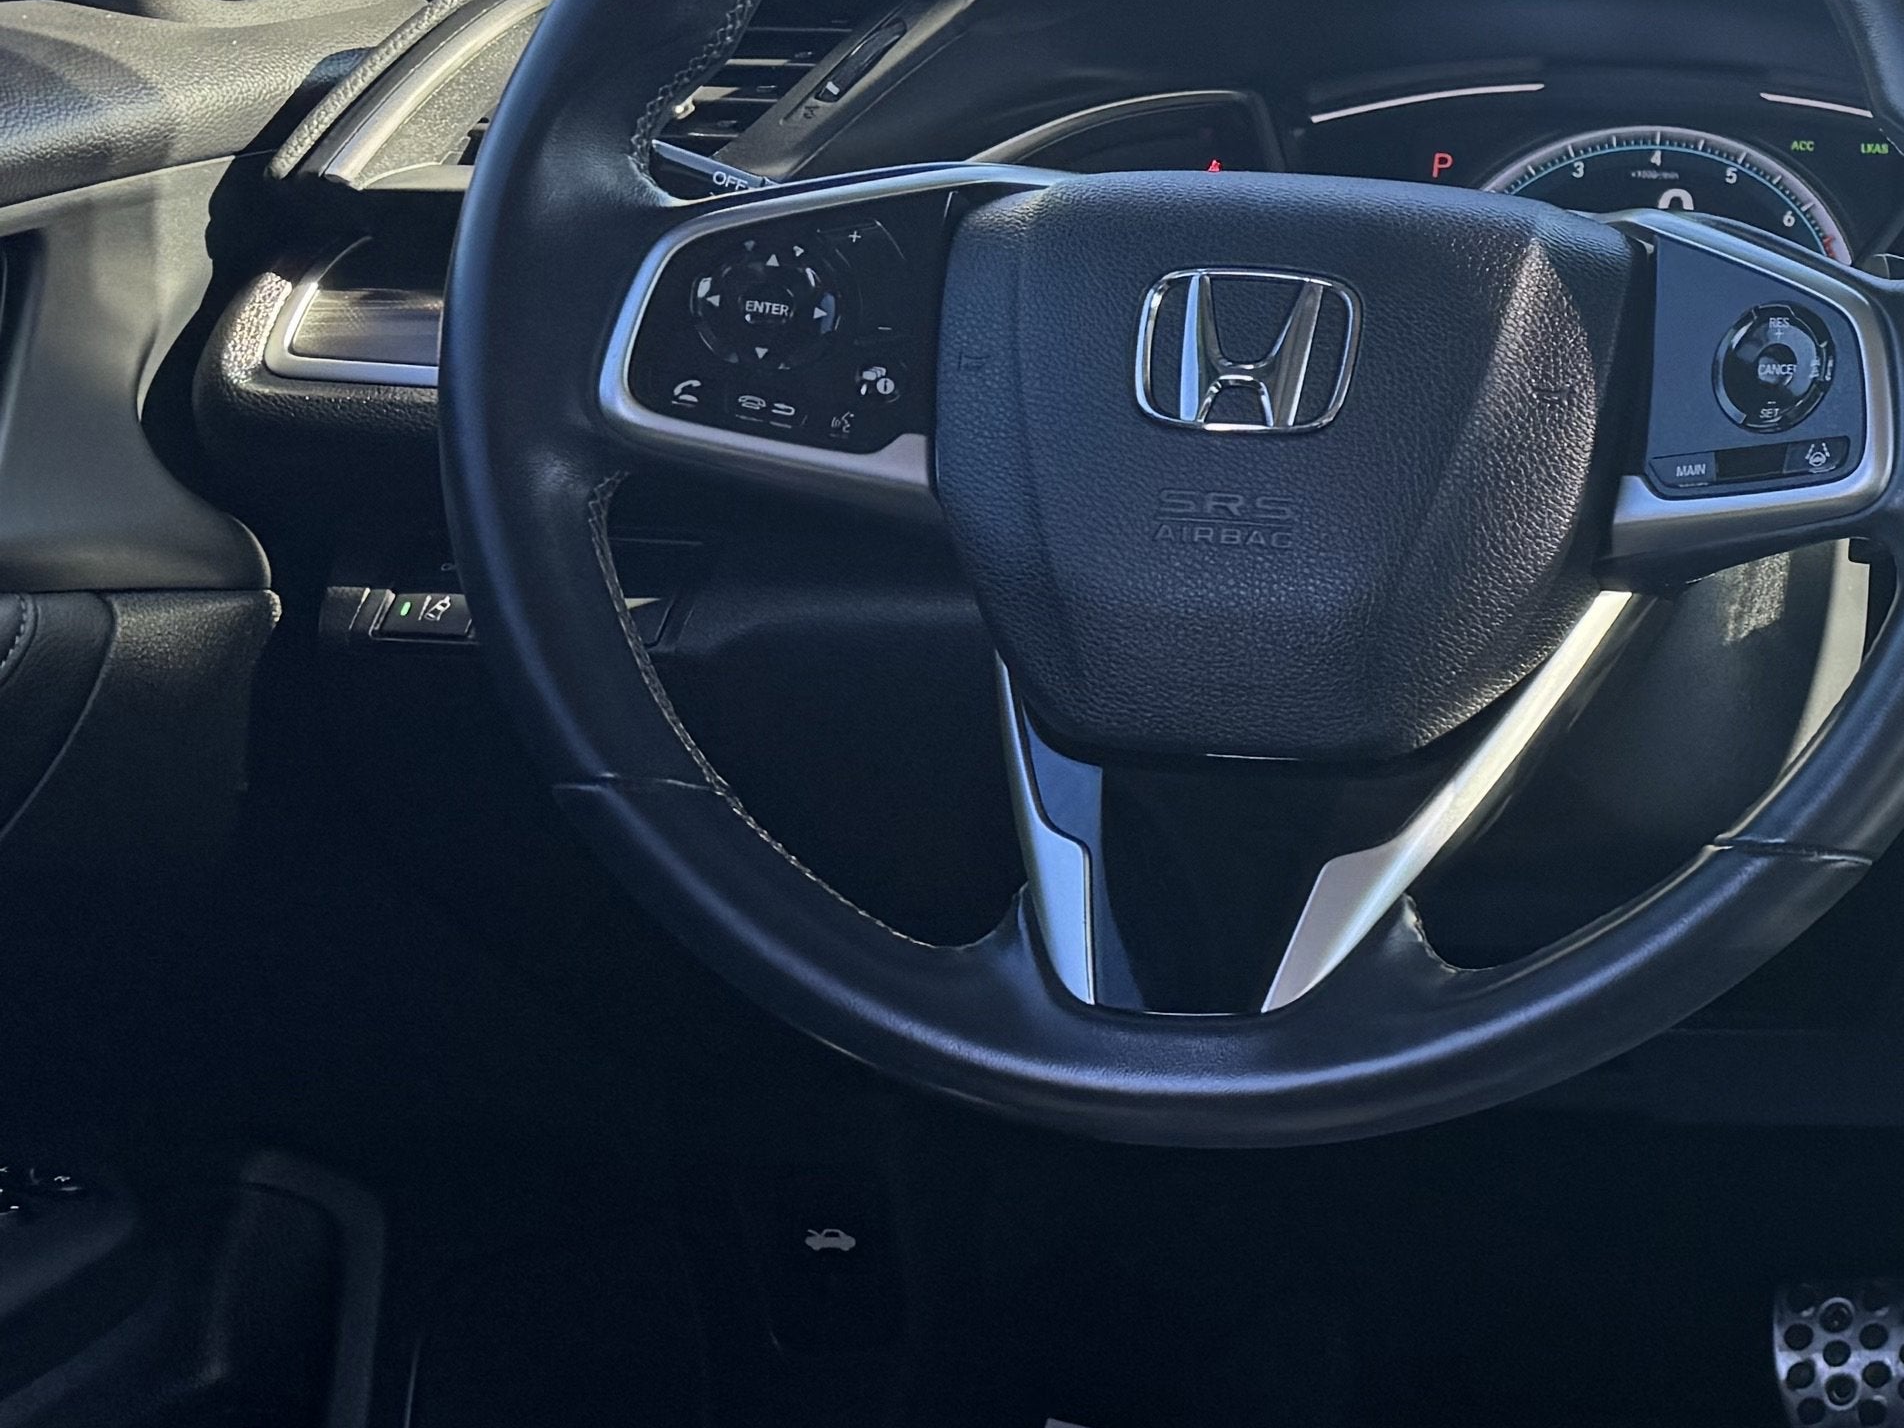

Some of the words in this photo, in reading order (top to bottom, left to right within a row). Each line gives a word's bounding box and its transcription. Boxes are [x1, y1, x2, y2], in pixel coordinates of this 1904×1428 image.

[1791, 140, 1815, 151] ACC
[1431, 152, 1453, 178] P
[1650, 150, 1662, 166] 4
[1572, 161, 1585, 178] 3
[1725, 167, 1738, 184] 5
[1783, 210, 1796, 227] 6
[745, 300, 790, 316] ENTER
[1769, 317, 1790, 328] RES
[1760, 408, 1780, 419] SET
[1676, 464, 1706, 477] MAIN
[1159, 489, 1297, 520] SRS
[1154, 524, 1294, 549] AIRBAG
